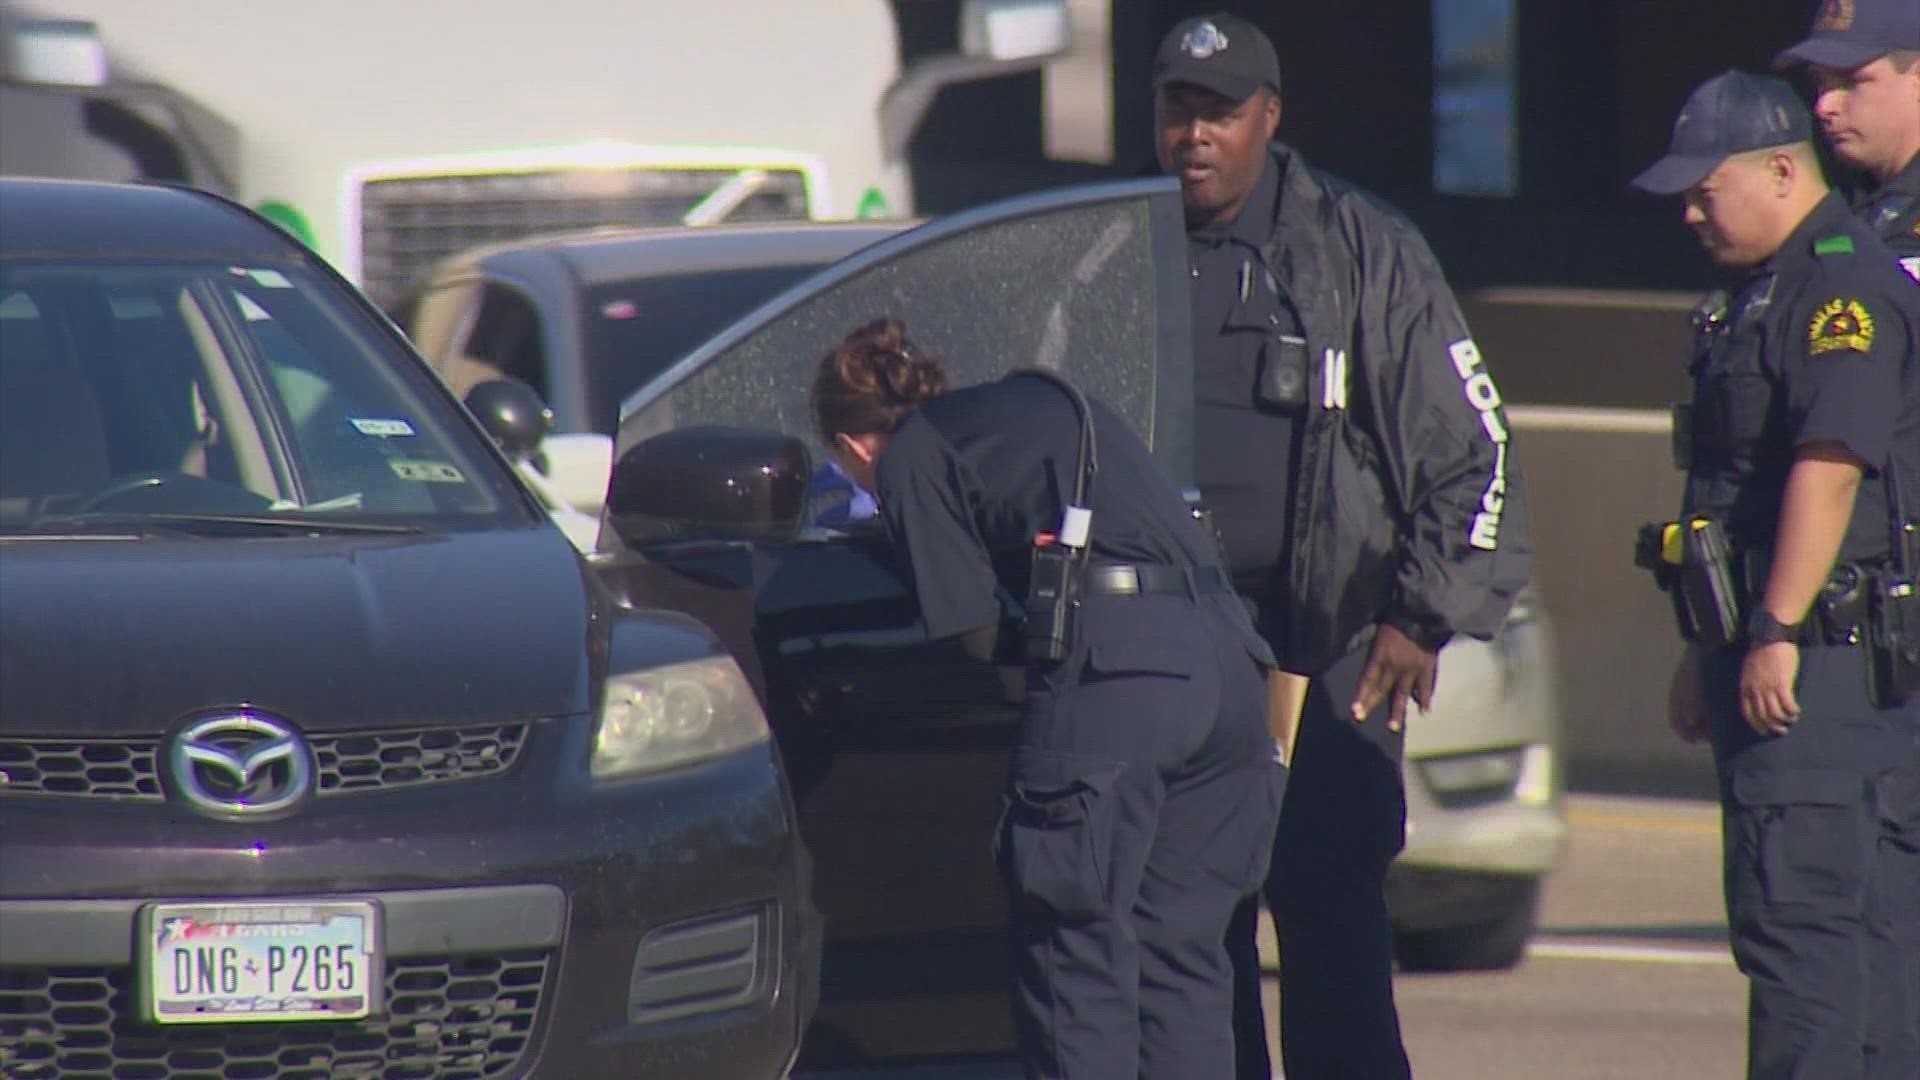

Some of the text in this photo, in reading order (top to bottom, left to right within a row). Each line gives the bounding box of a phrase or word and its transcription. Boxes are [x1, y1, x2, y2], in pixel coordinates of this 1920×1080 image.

[1449, 338, 1508, 551] POLICE
[174, 944, 354, 994] DN6 P265
